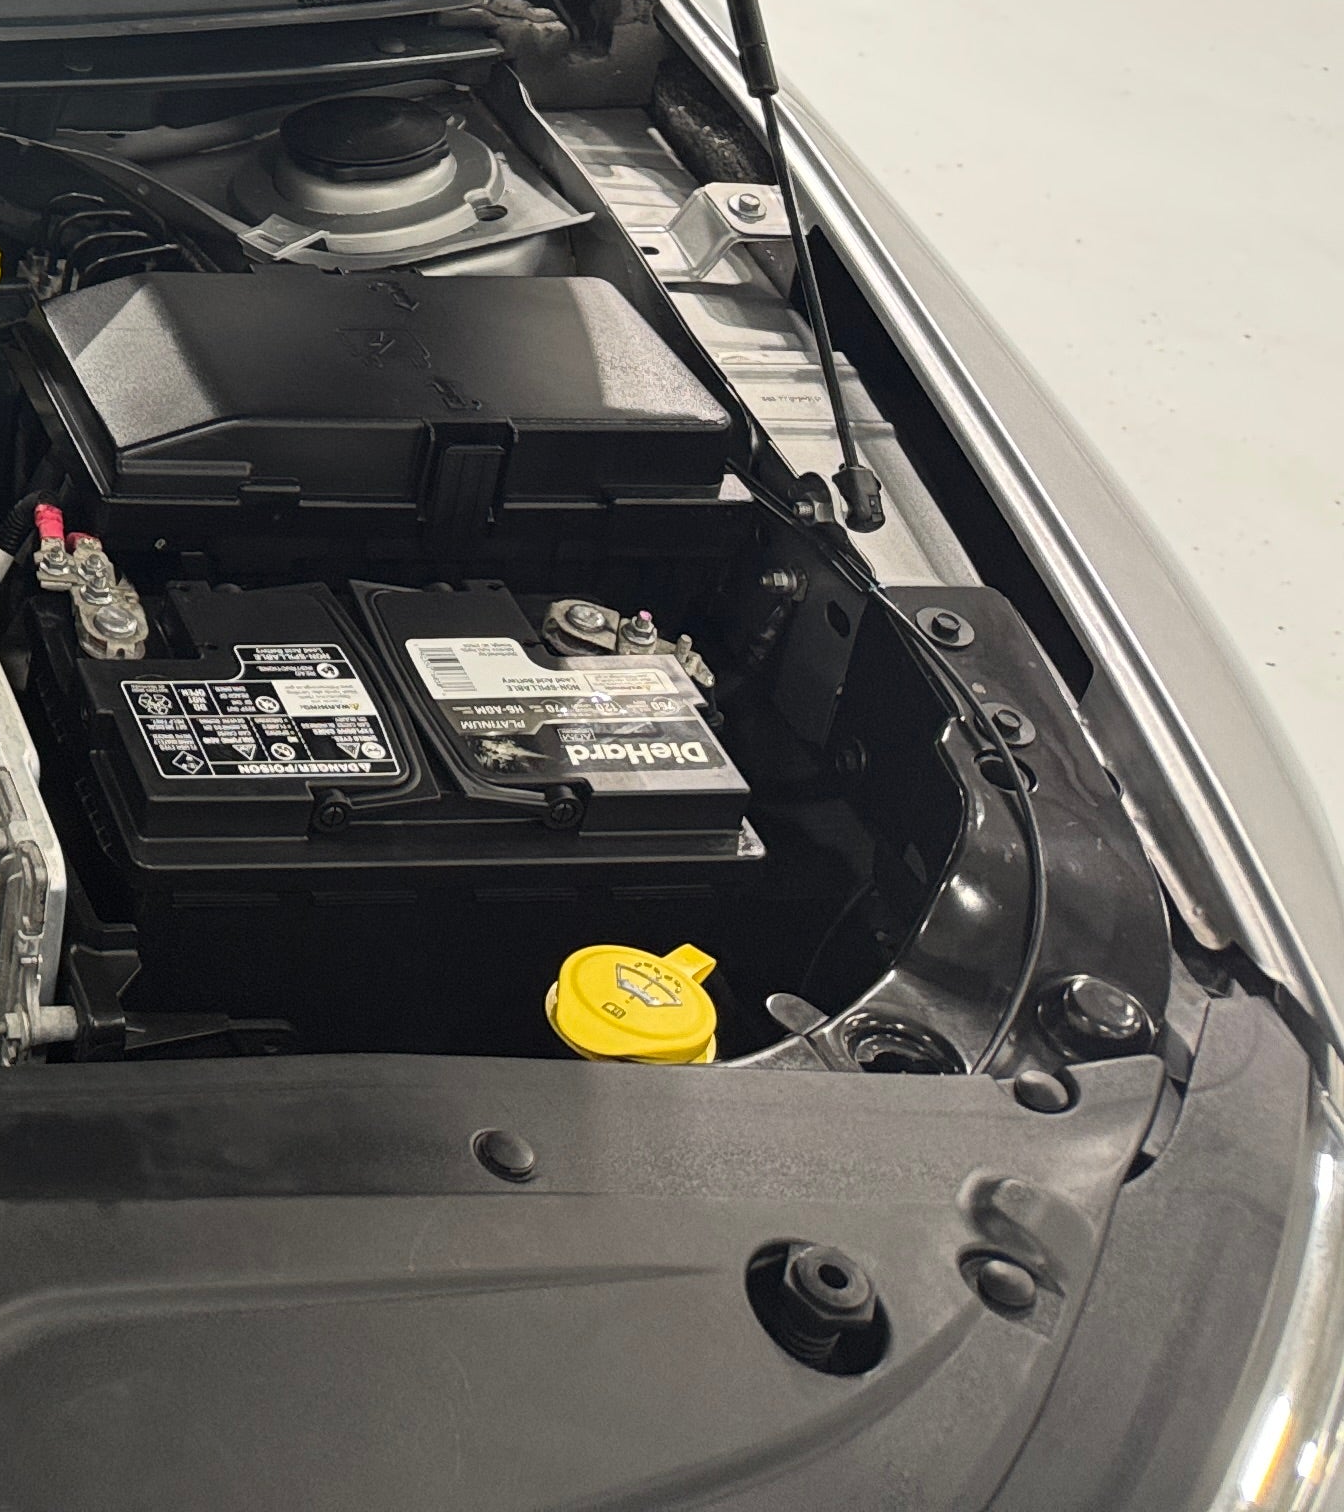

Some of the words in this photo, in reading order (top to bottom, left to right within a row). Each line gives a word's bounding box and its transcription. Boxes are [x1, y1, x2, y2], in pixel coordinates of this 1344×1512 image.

[460, 720, 526, 729] PLATINUM
[565, 741, 709, 766] DieHard
[238, 763, 359, 774] DANGER/POISON
